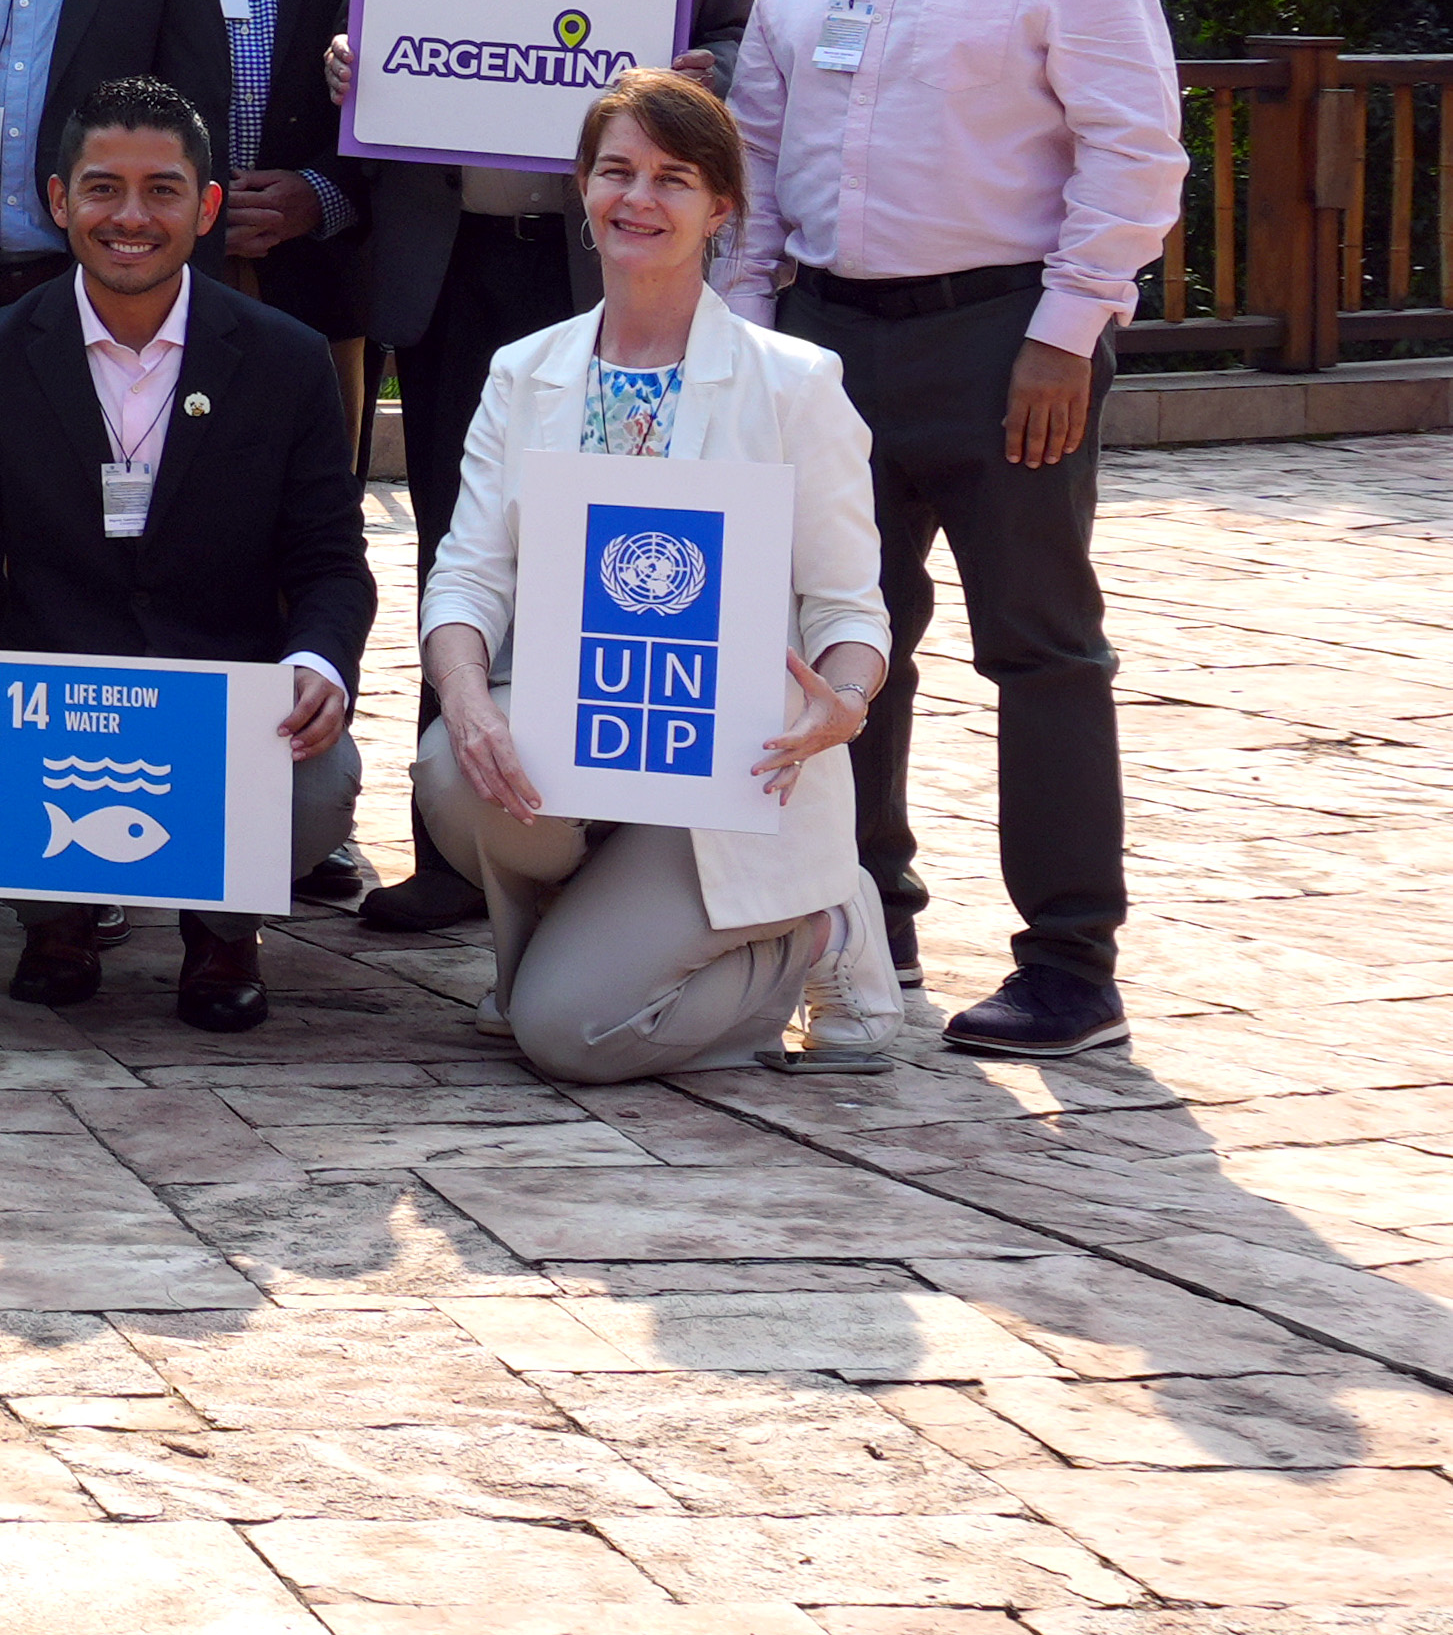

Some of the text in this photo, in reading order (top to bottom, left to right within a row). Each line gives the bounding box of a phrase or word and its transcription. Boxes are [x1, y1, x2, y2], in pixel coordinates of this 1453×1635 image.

[7, 681, 50, 729] 14
[64, 683, 159, 708] LIFE BELOW
[64, 710, 120, 734] WATER
